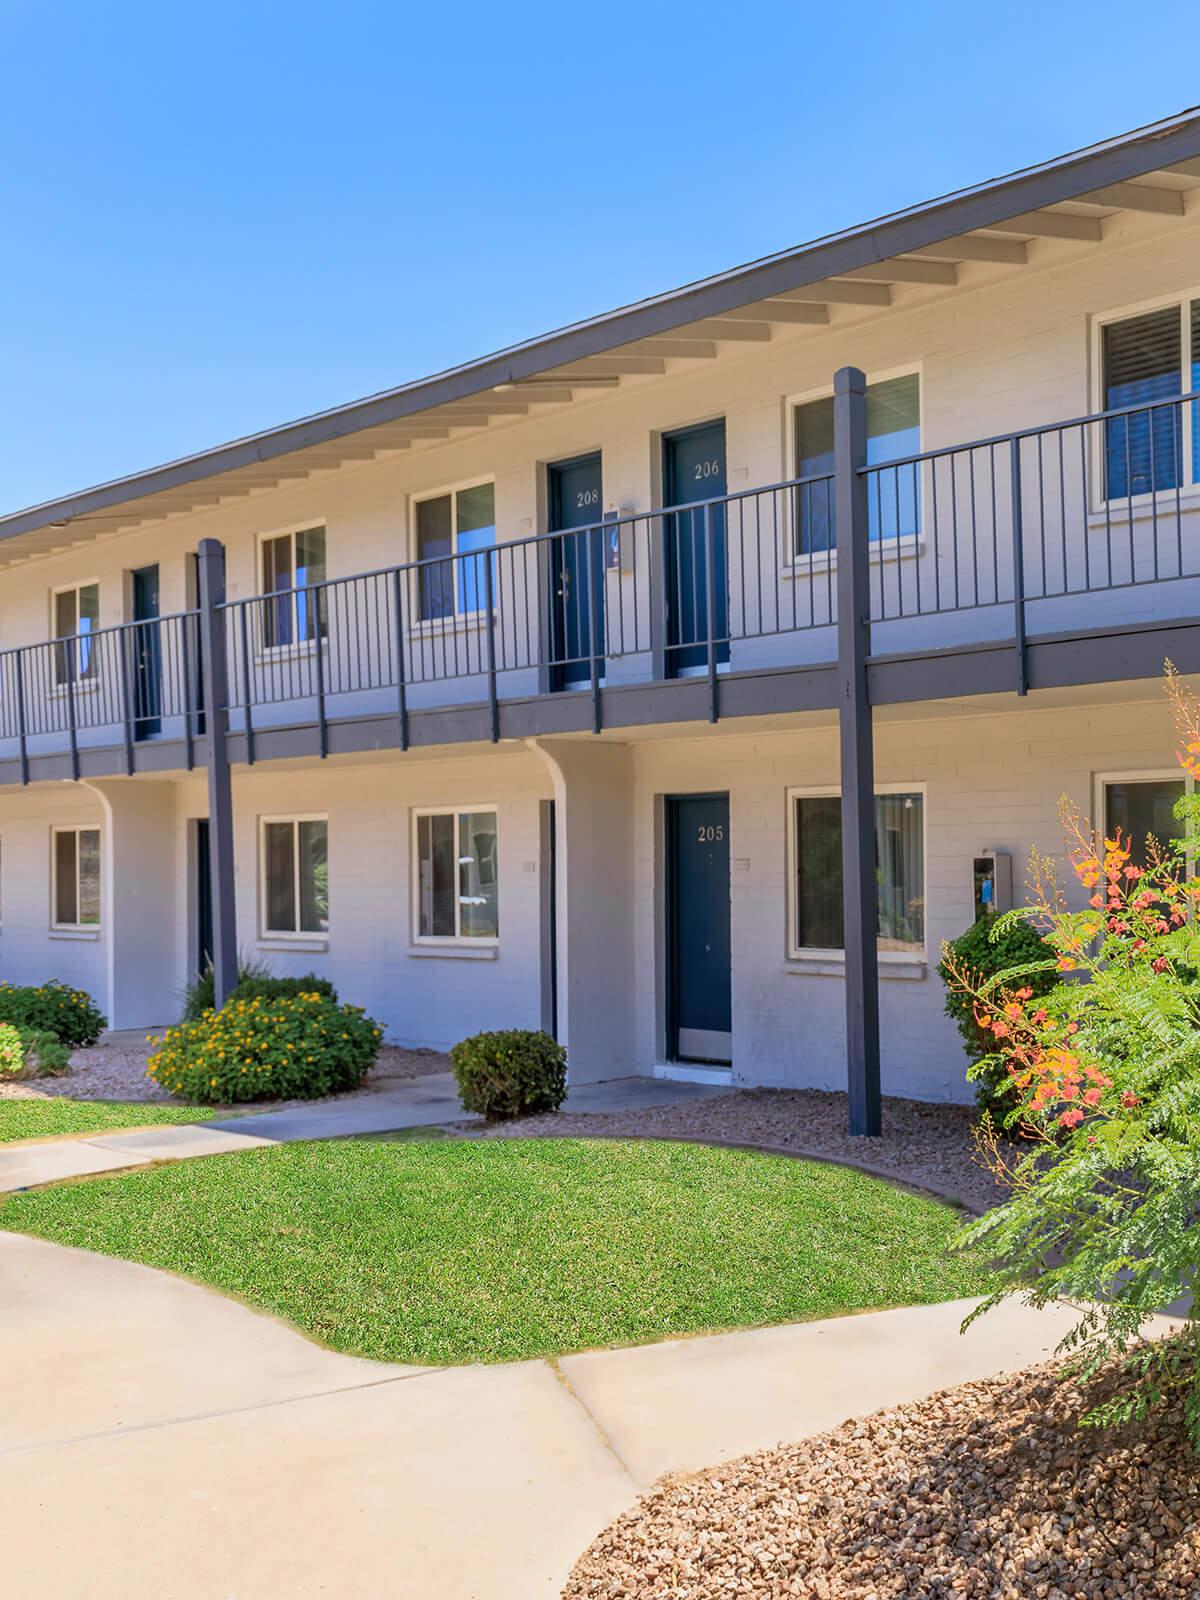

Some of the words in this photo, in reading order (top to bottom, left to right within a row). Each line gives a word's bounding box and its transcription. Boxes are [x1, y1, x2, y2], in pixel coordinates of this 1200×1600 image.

[695, 460, 719, 480] 206
[577, 489, 598, 507] 208
[698, 826, 723, 842] 205
